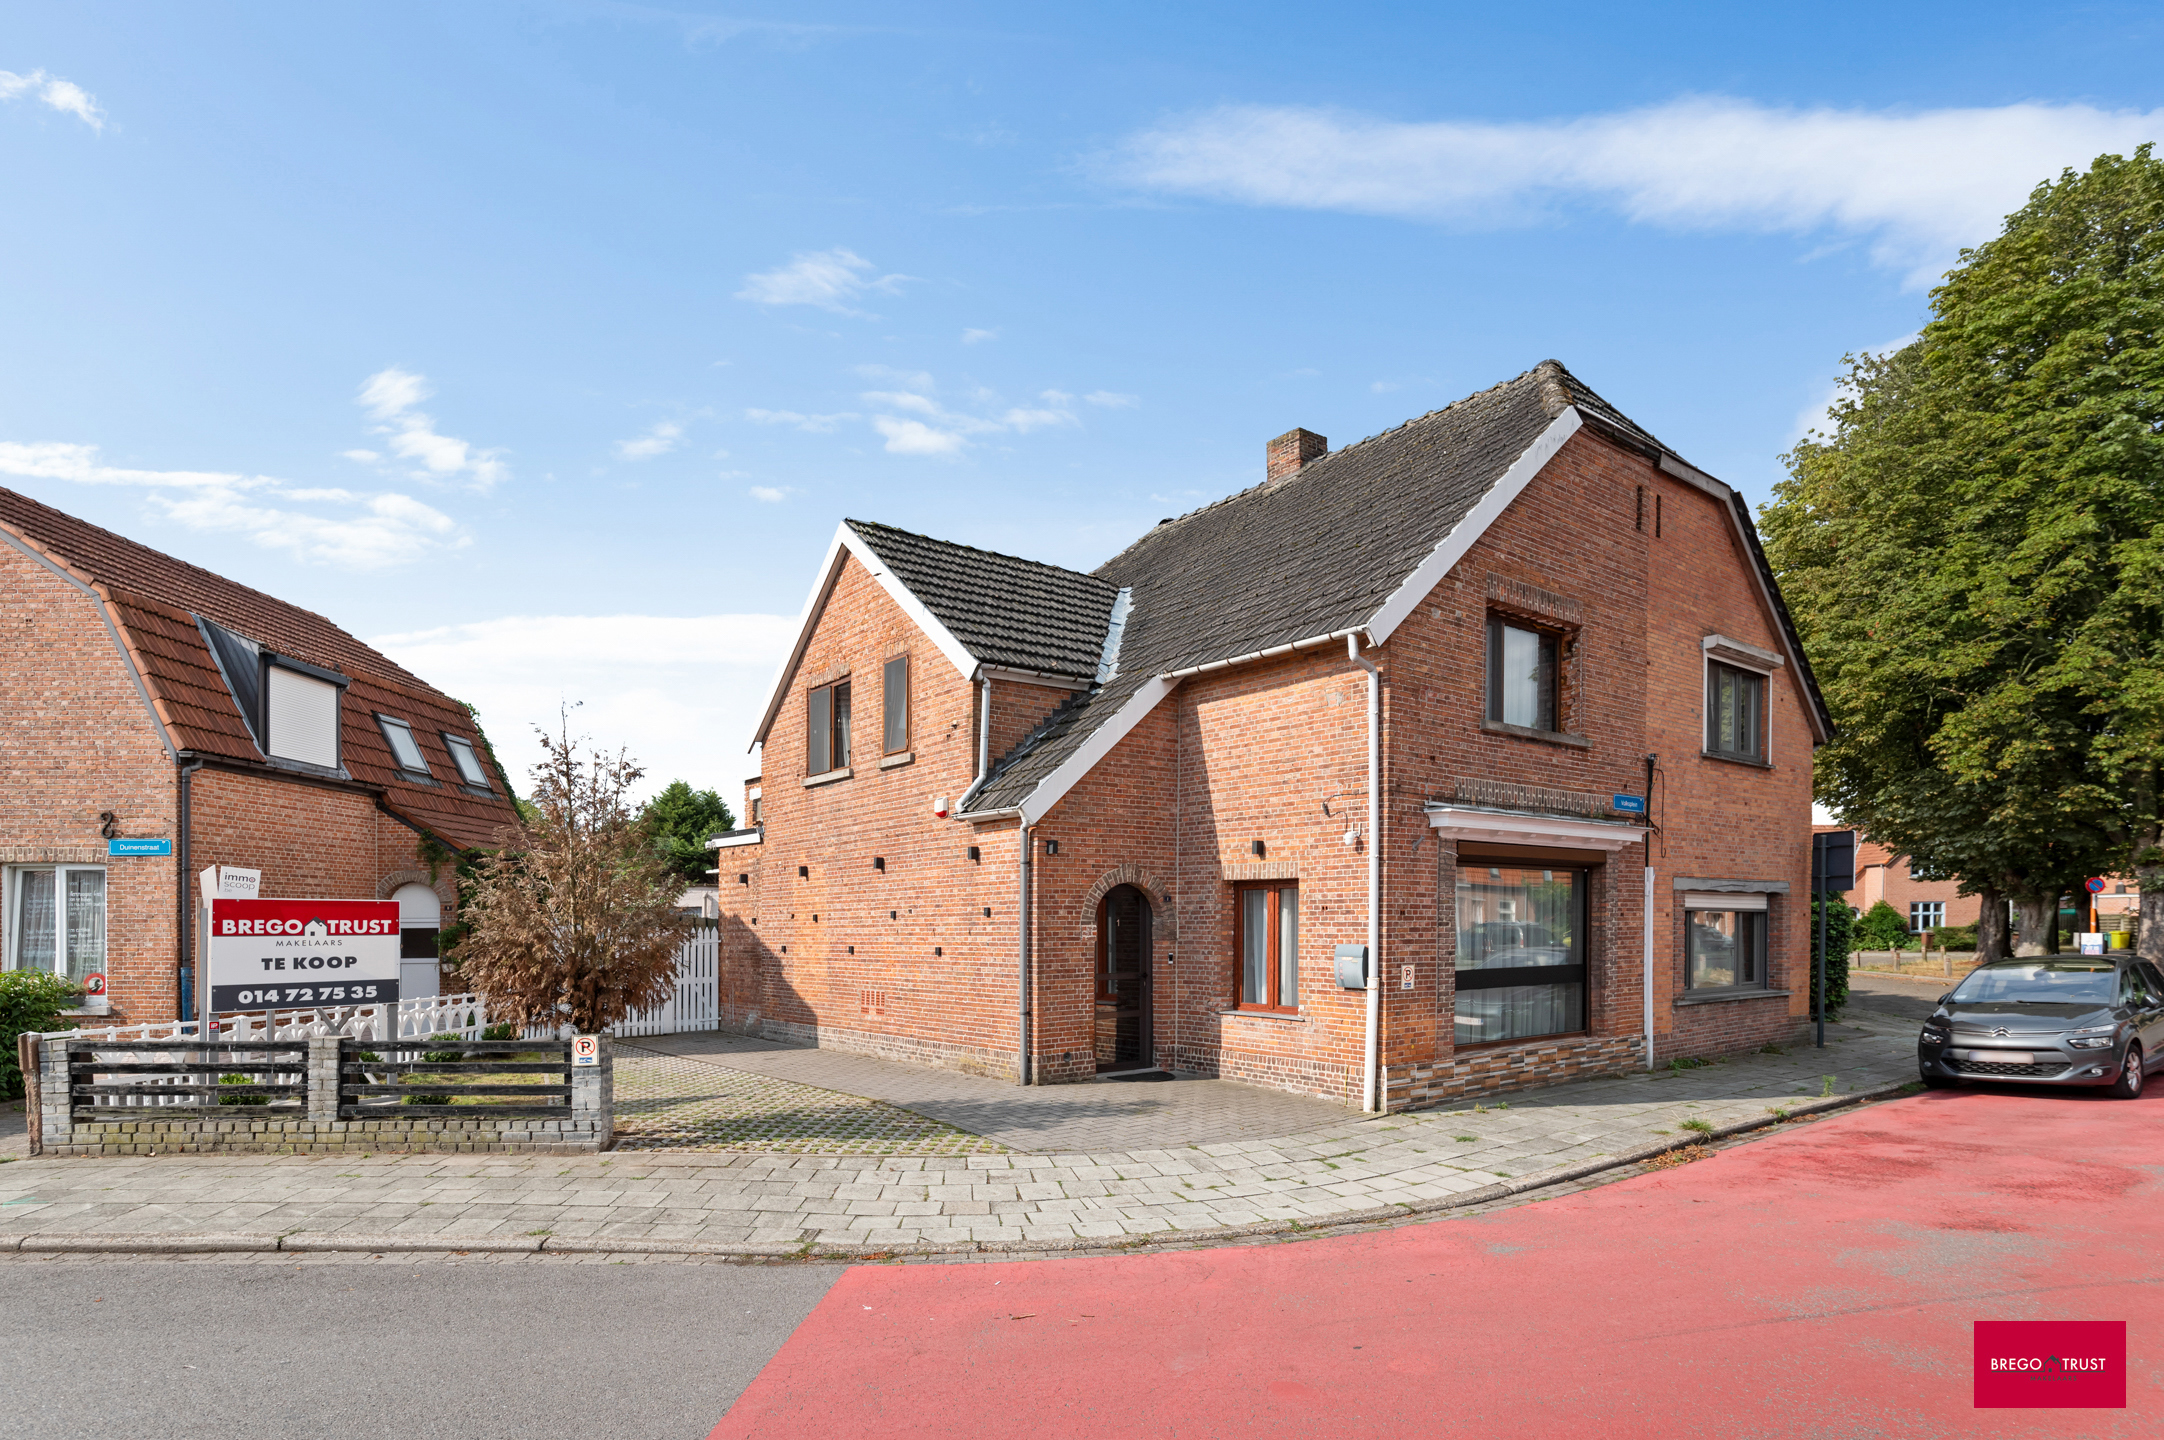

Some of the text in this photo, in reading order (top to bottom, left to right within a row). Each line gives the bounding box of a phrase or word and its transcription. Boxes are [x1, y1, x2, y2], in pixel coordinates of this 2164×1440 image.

[224, 872, 256, 883] immo
[224, 881, 256, 891] scoop
[222, 918, 392, 934] BREGO TRUST
[1116, 919, 1120, 927] 1
[275, 939, 343, 947] MAKELAARS
[261, 956, 358, 970] TE KOOP
[238, 985, 378, 1004] 014 72 75 35
